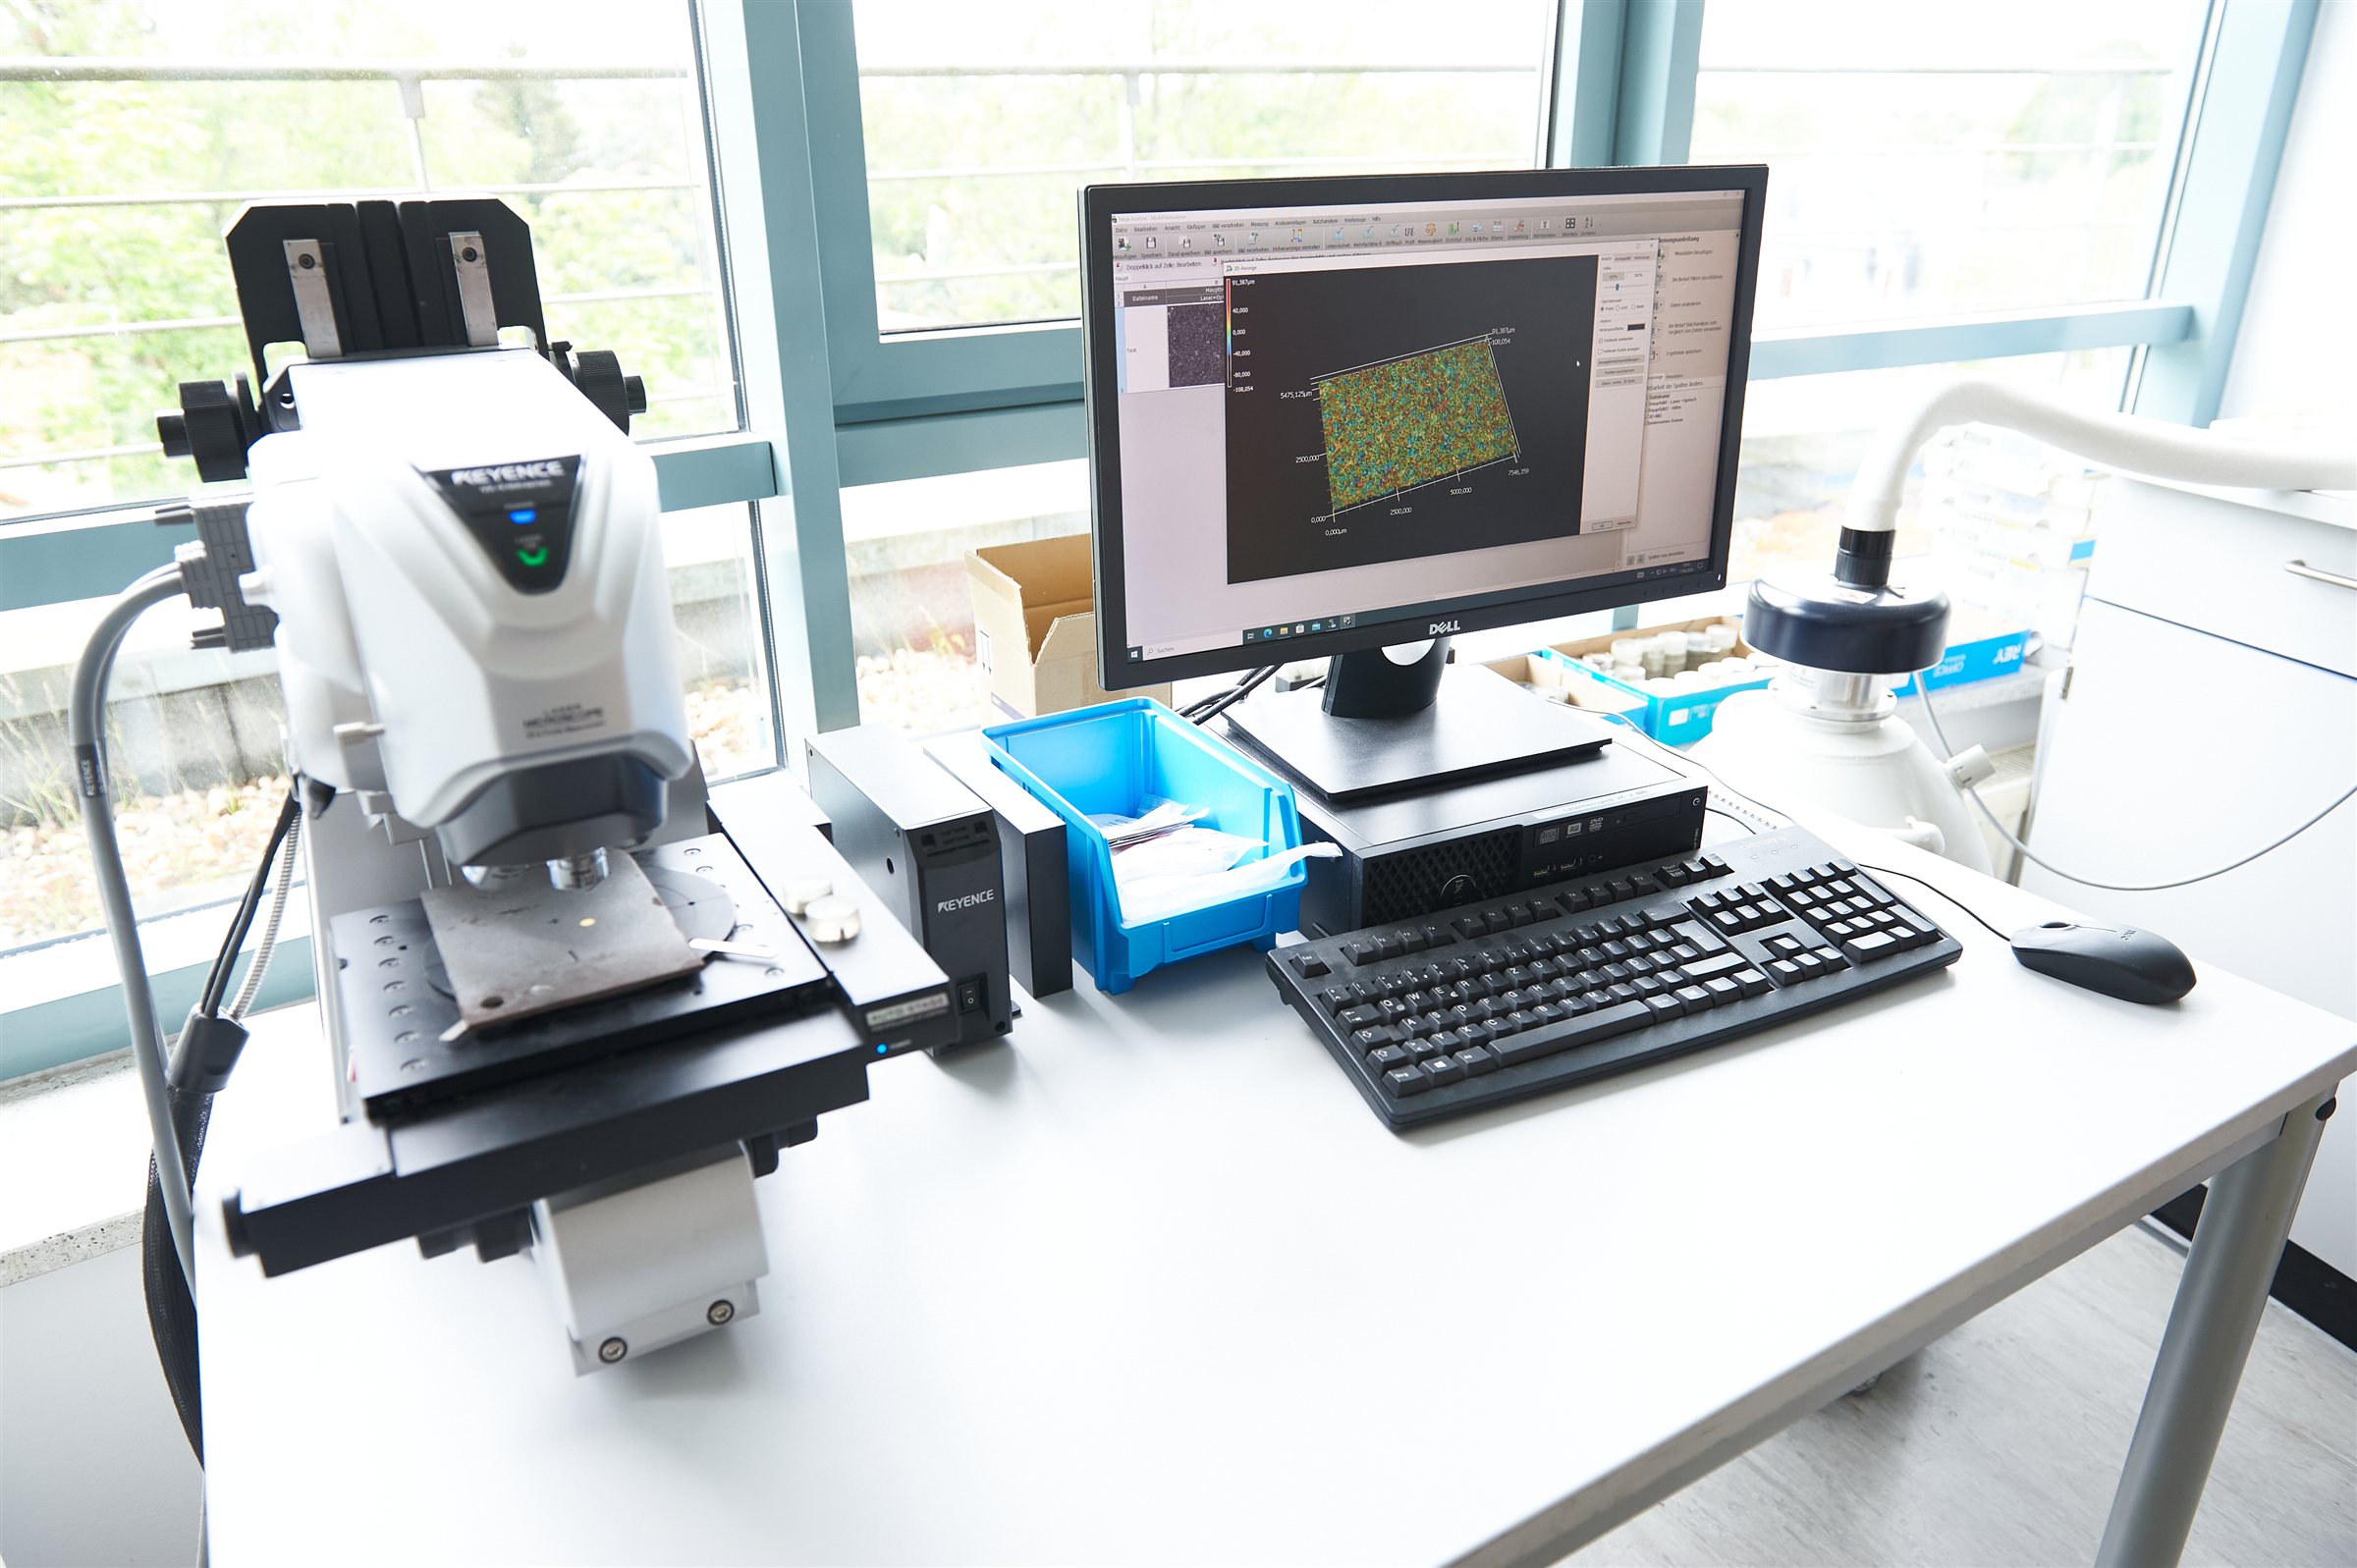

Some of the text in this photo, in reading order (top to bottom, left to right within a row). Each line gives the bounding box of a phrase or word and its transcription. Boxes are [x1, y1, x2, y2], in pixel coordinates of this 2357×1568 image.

[1280, 390, 1313, 399] 5475,125µm
[1295, 455, 1319, 463] 2500,000
[451, 460, 565, 487] KEYENCE
[1450, 487, 1472, 495] 5000,000
[1390, 507, 1413, 515] 2500,000
[1429, 620, 1461, 635] DELL
[937, 889, 995, 914] KEYENCE
